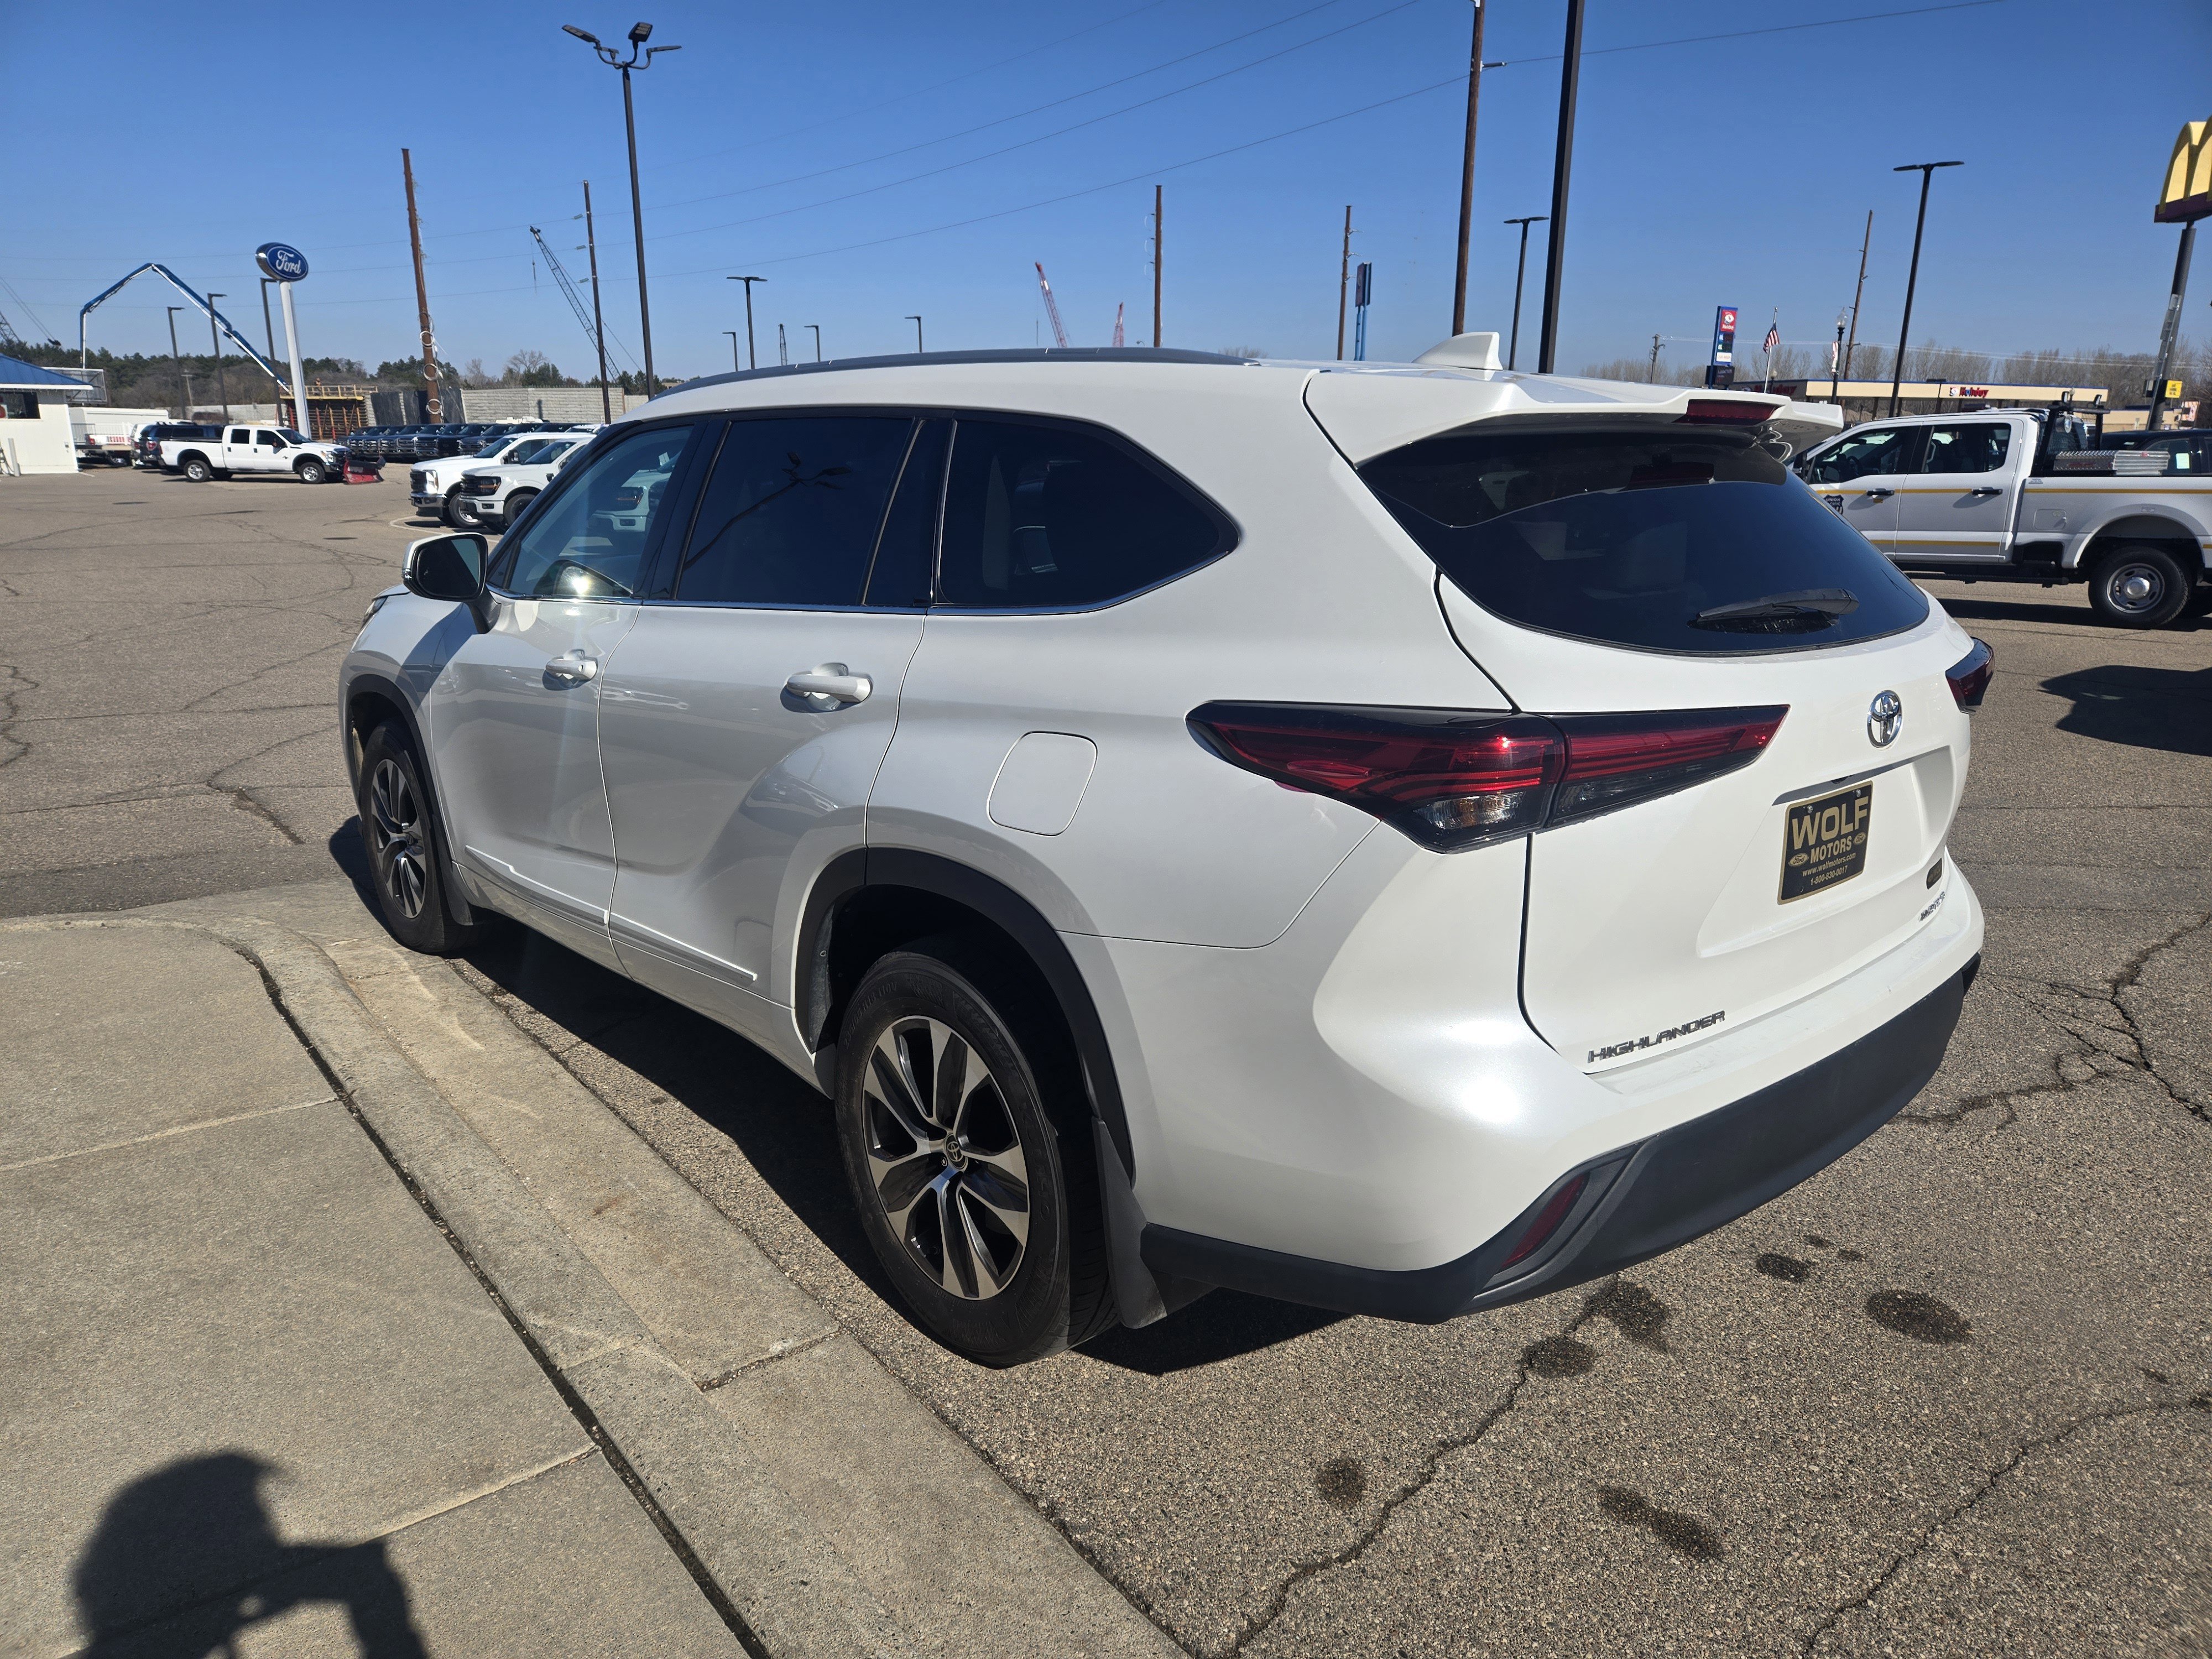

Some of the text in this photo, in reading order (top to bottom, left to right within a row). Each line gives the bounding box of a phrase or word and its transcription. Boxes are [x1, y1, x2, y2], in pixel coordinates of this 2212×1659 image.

[275, 250, 301, 274] Ford
[1792, 796, 1869, 850] WOLF
[1793, 855, 1805, 864] Ford
[1810, 836, 1852, 864] MOTORS
[1802, 852, 1856, 877] www.wolfmotors.com
[1810, 865, 1848, 886] 1-800-830-0017
[1587, 1010, 1725, 1064] HIGHLANDER
